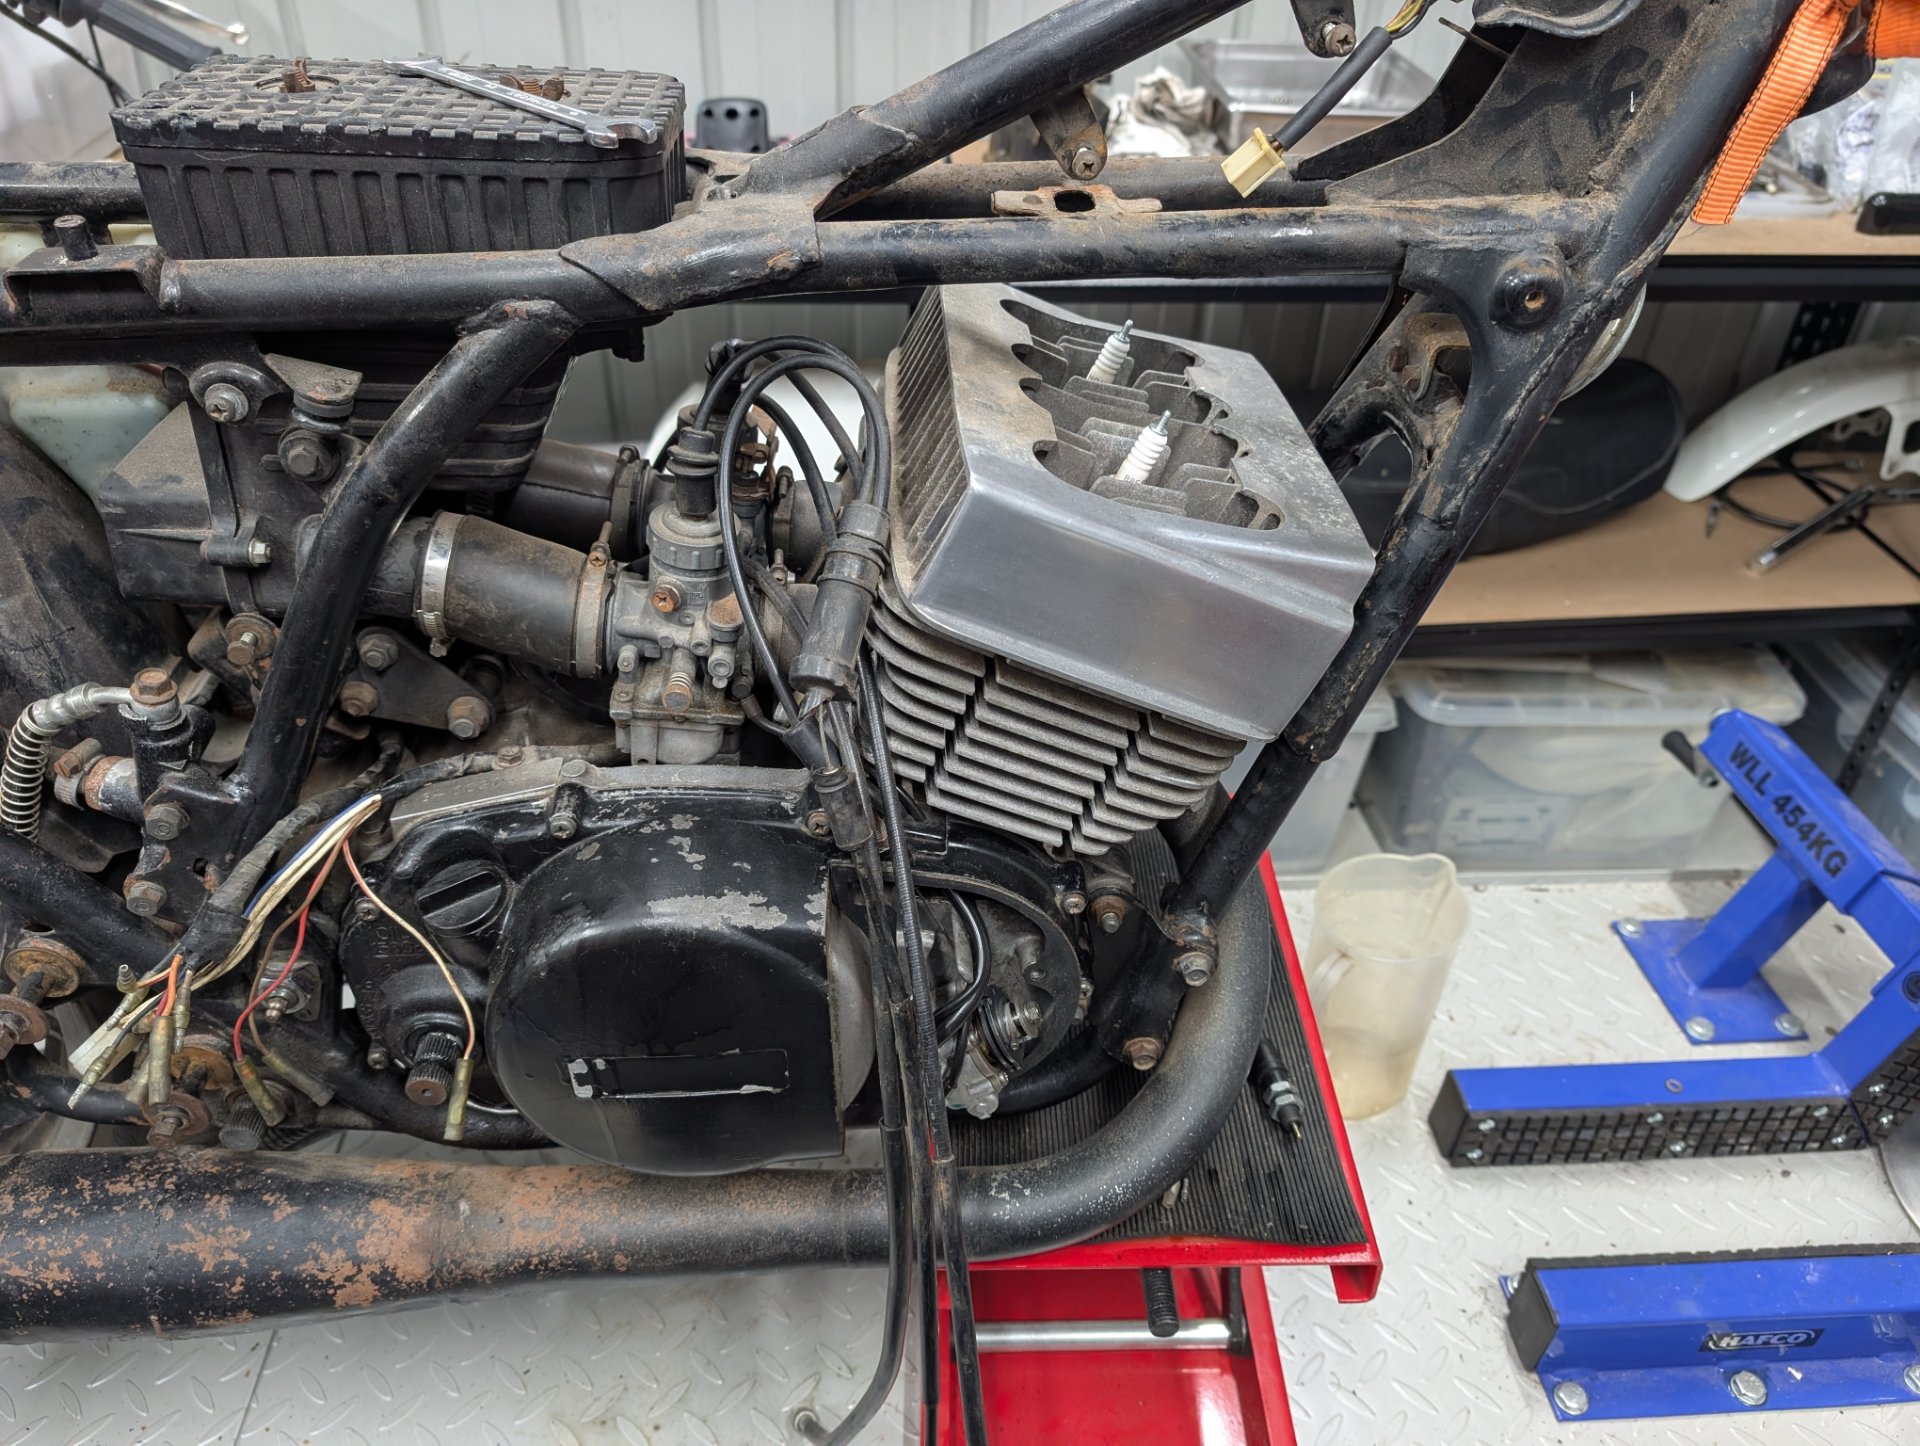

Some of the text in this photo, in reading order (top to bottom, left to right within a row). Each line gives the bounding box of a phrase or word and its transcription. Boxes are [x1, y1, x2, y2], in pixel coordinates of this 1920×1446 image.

[1729, 740, 1848, 879] WLL 454KG
[1718, 1332, 1808, 1348] HAFCO
